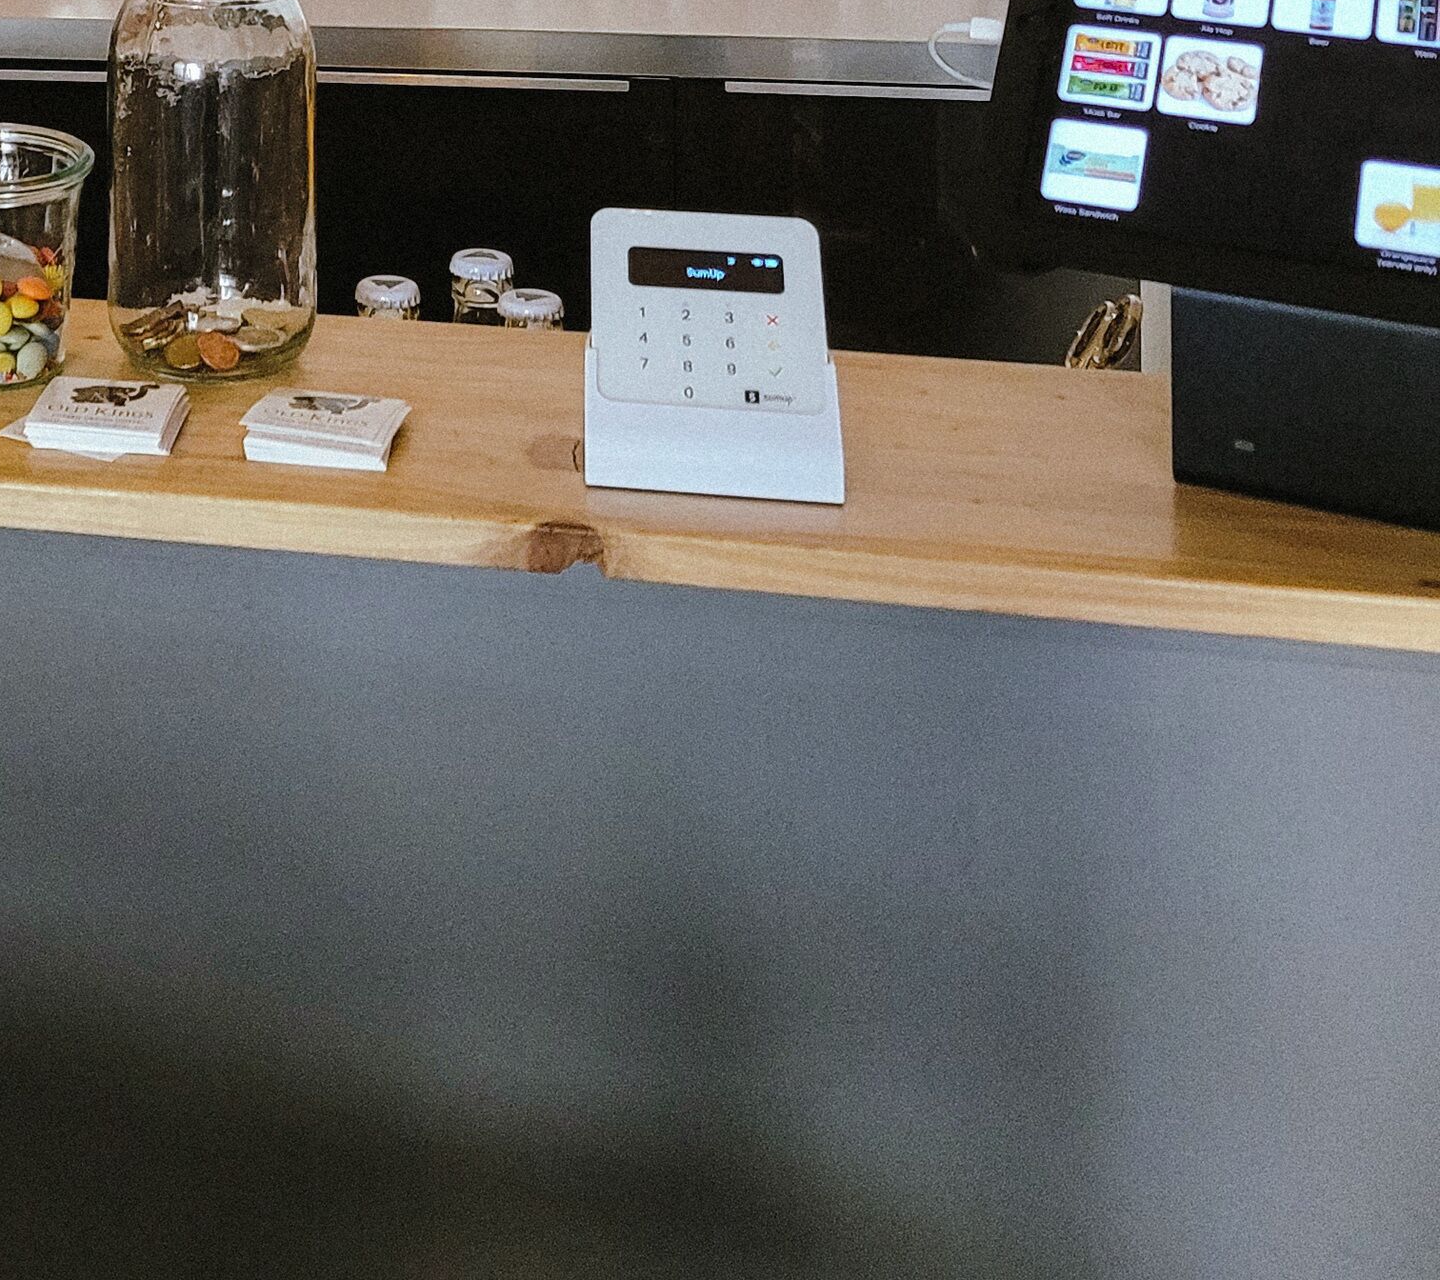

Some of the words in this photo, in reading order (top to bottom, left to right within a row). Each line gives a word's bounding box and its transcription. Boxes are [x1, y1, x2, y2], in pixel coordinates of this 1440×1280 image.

[681, 309, 691, 321] 2
[724, 311, 735, 324] 3
[725, 337, 736, 350] 6
[640, 357, 649, 369] 7
[684, 386, 694, 399] 0
